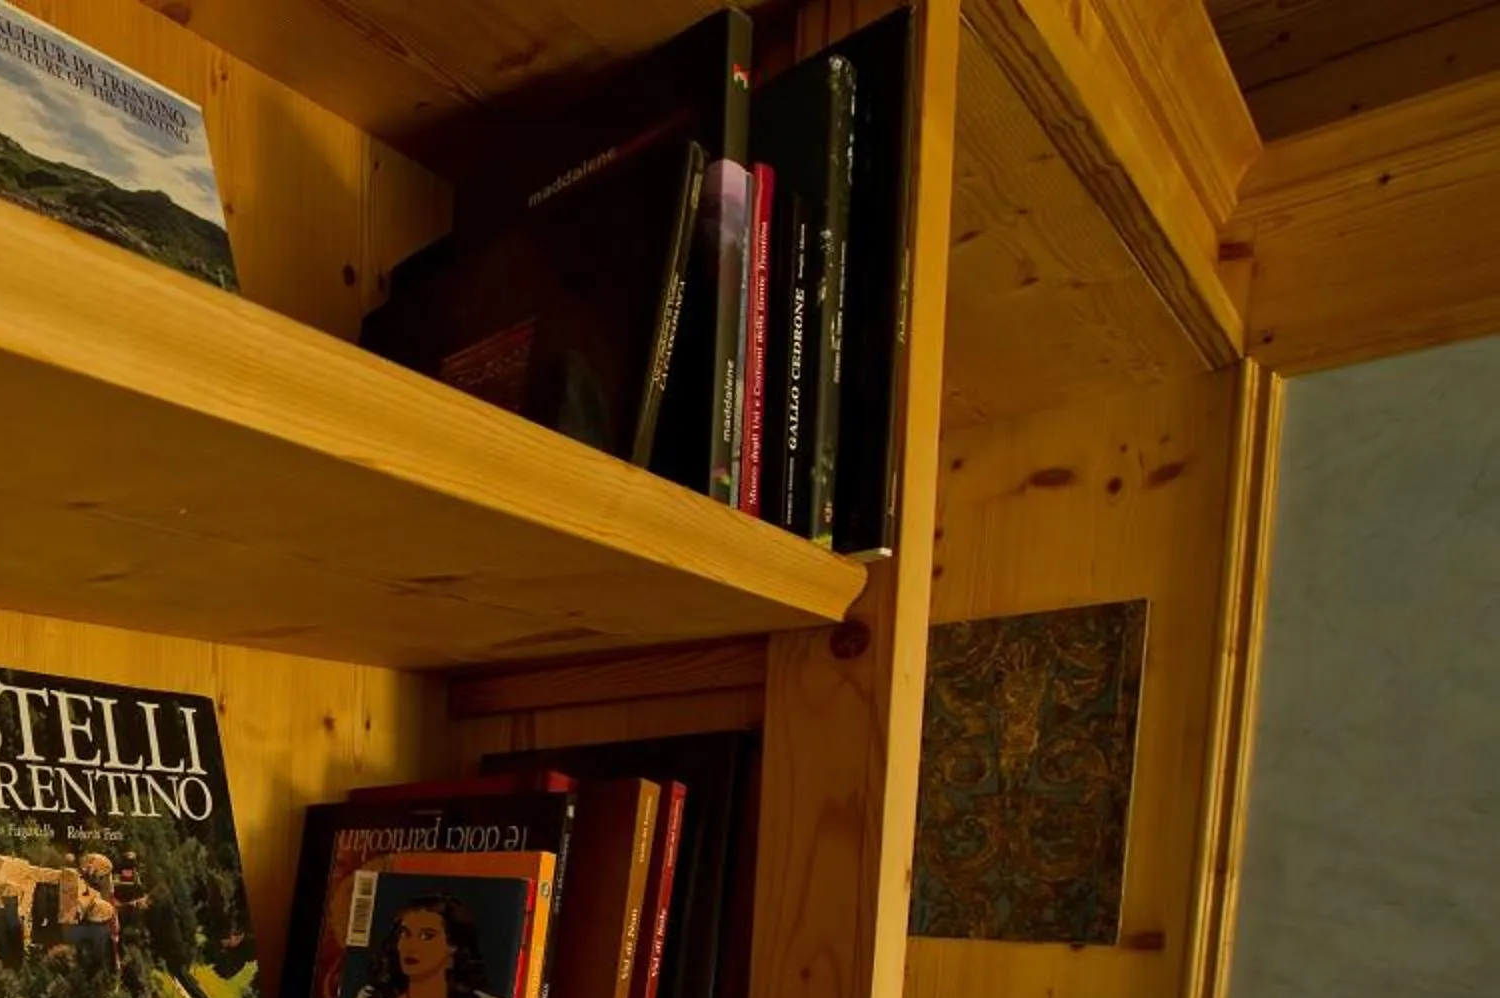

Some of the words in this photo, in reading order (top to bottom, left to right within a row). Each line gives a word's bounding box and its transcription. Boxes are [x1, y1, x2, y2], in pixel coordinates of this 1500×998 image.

[68, 70, 85, 90] OF
[92, 83, 118, 108] THE
[122, 99, 190, 145] TRENTINO
[73, 54, 95, 79] IM
[98, 67, 187, 129] TRENTINO
[528, 145, 617, 209] maddalene
[790, 287, 806, 381] CEDRONE
[723, 358, 736, 443] maddalene
[787, 384, 801, 451] GALLO
